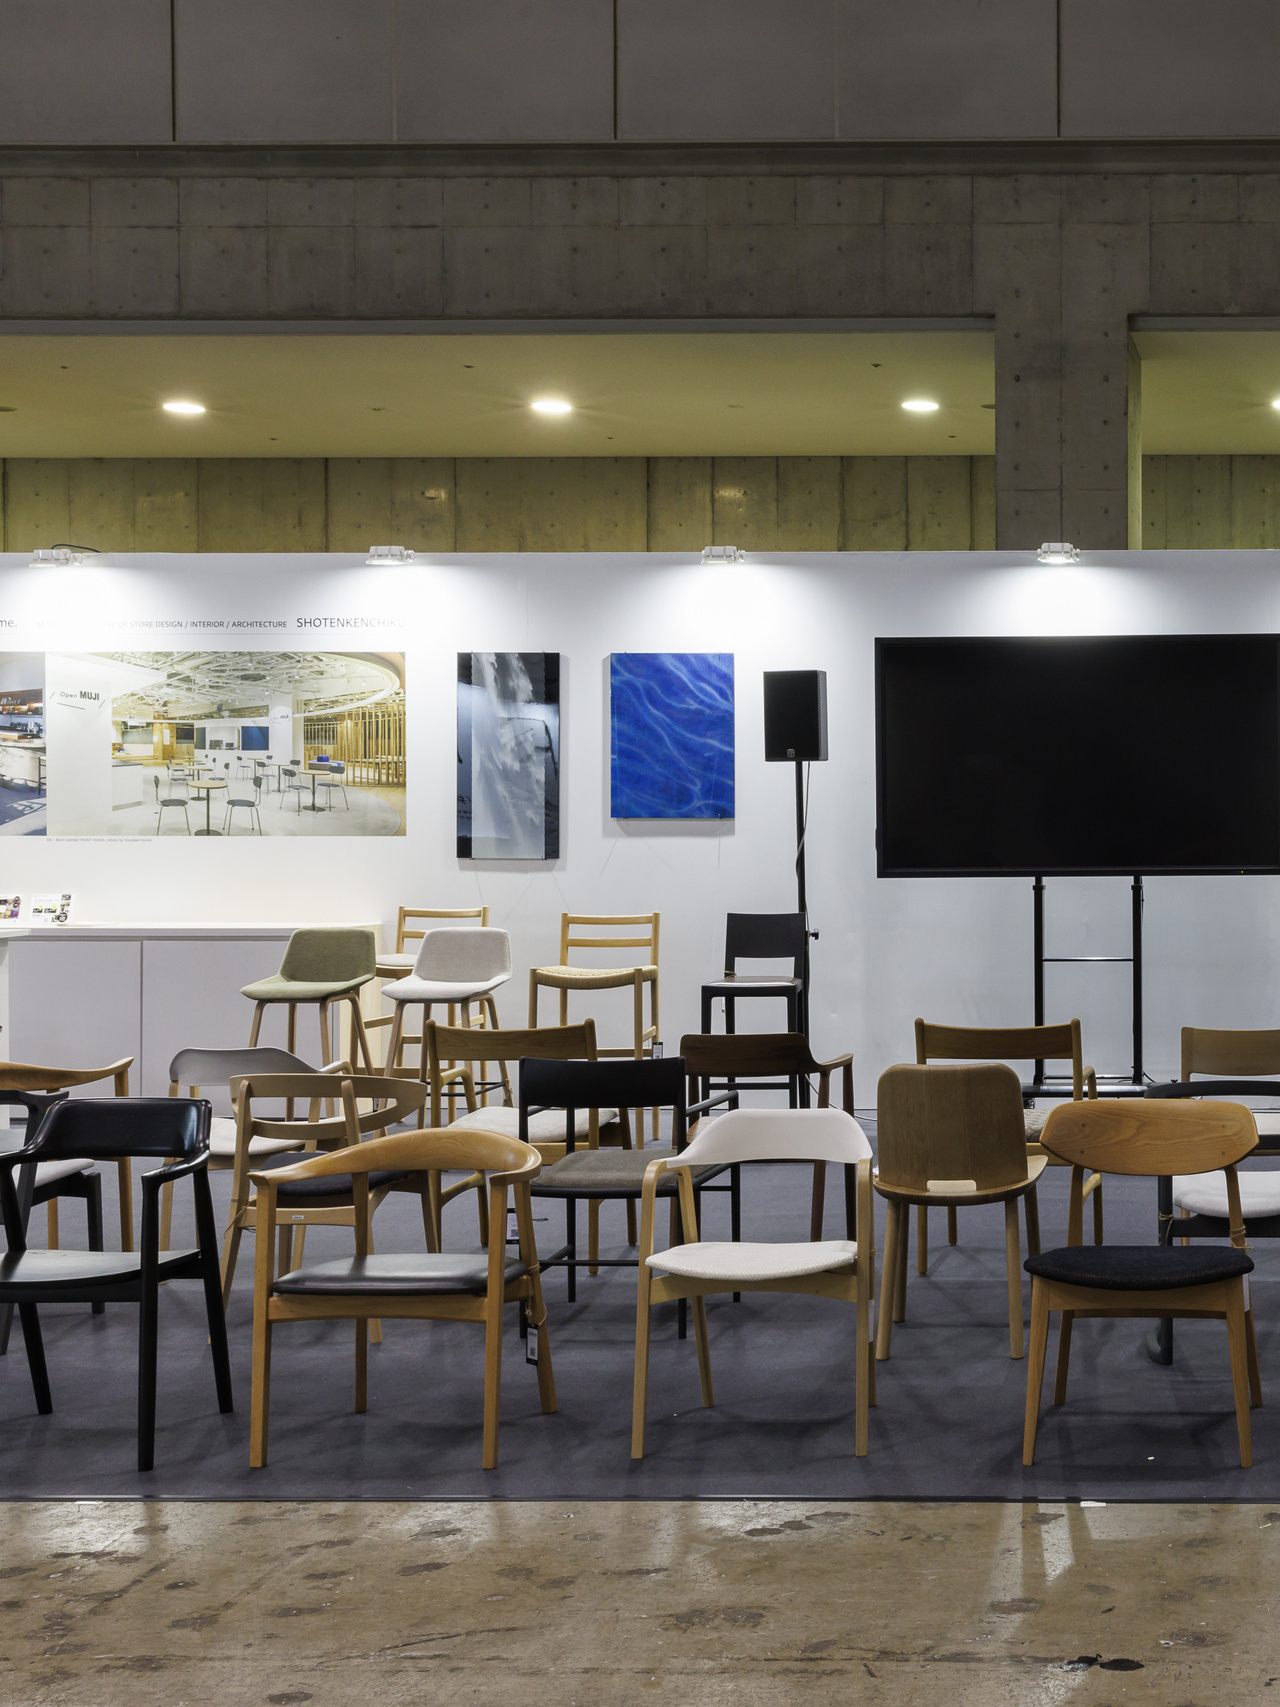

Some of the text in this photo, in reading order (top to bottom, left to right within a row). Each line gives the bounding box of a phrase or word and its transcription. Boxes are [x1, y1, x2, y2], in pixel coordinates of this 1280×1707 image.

[130, 620, 154, 628] STORE
[155, 620, 183, 628] DESIGN
[190, 620, 224, 628] INTERIOR
[231, 620, 287, 628] ARCHITECTURE
[296, 617, 407, 628] SHOTENKENCHIKU
[59, 690, 100, 701] Open MUJI
